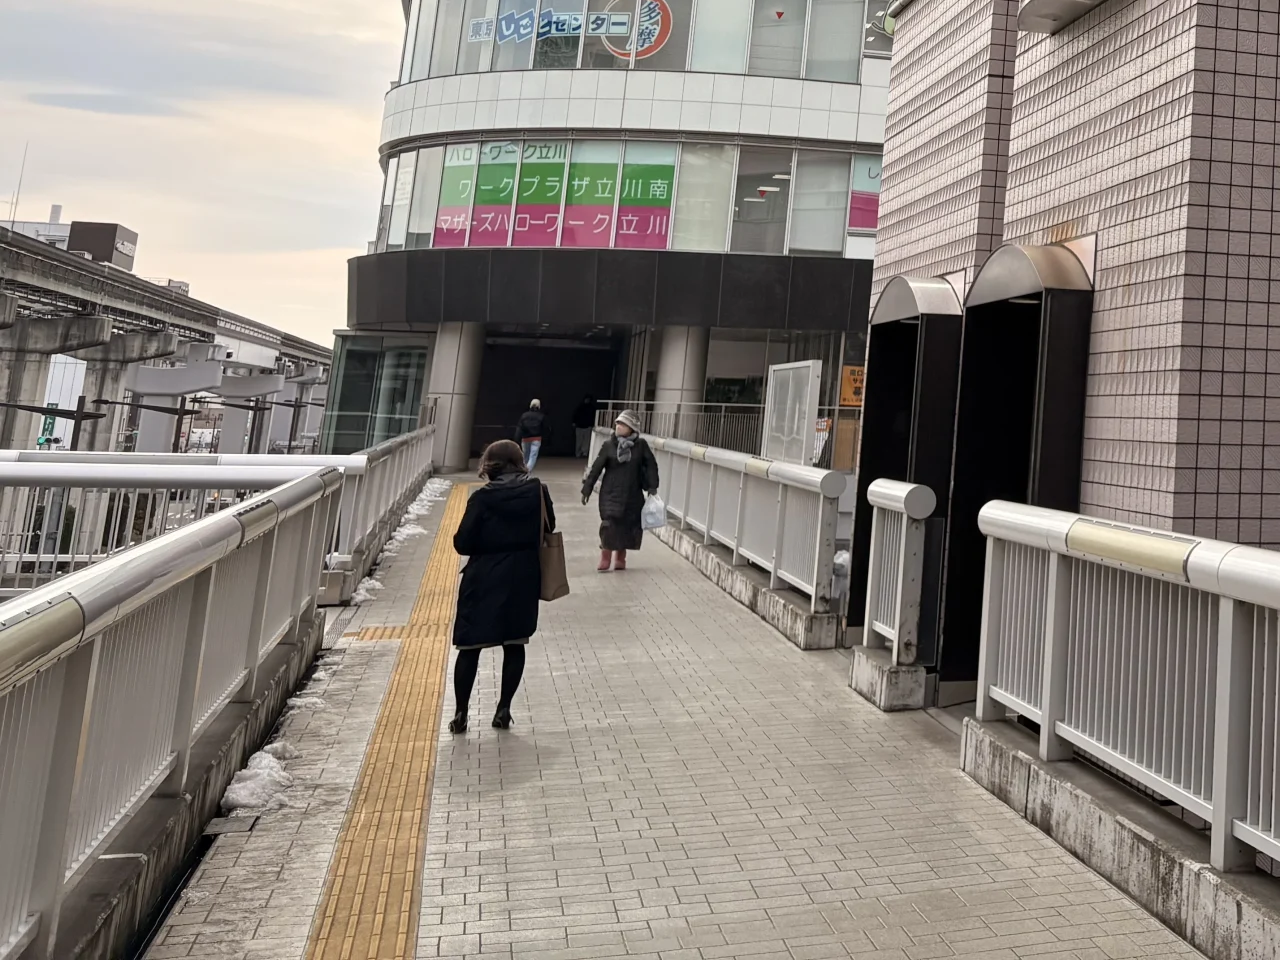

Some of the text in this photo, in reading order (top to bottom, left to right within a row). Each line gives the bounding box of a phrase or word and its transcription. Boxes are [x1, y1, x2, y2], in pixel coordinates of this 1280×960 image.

[449, 143, 567, 162] ハローワーク立川
[459, 175, 668, 199] ワークプラザ立川南
[440, 212, 667, 235] マザーズハローワーク立川
